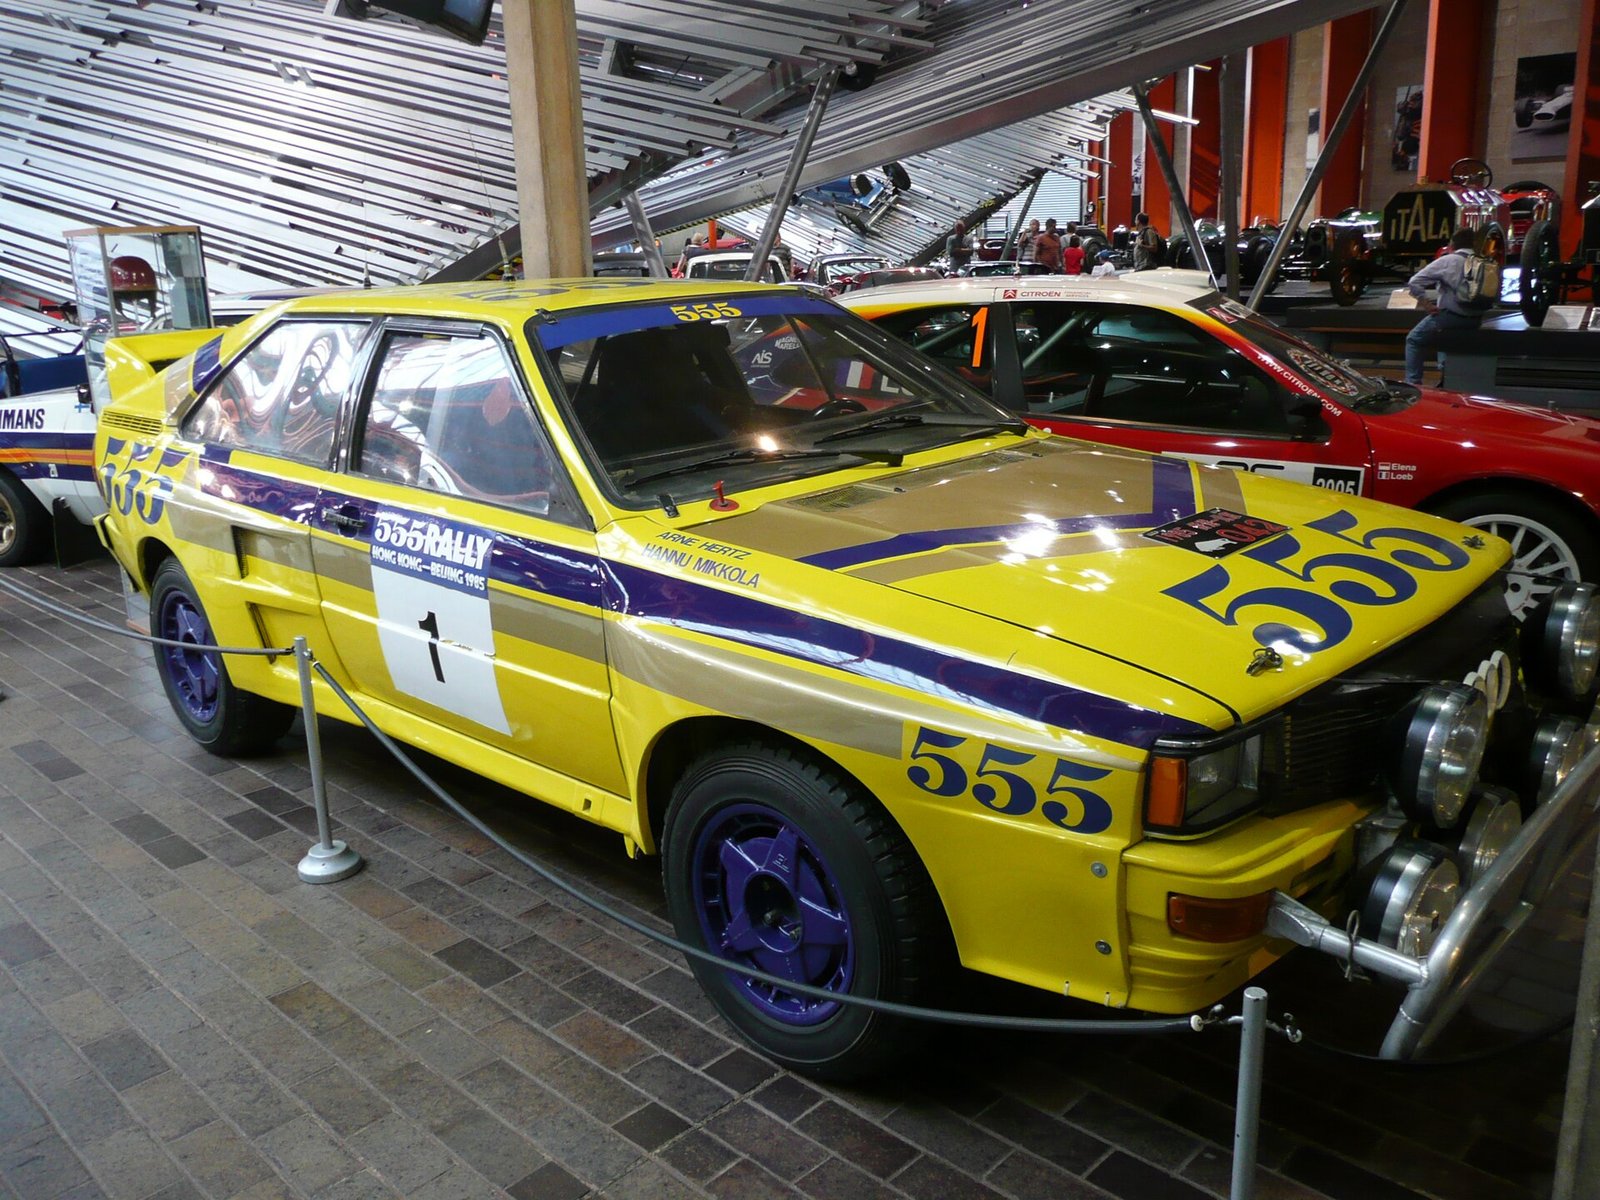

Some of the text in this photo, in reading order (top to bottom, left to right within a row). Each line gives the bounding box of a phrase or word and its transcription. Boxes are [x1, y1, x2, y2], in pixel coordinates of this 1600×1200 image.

[1390, 194, 1450, 242] ITALA
[670, 302, 742, 322] 555
[1020, 290, 1061, 298] CITROËN
[971, 307, 988, 367] 1
[0, 408, 45, 430] MANS
[100, 436, 192, 525] 555
[1391, 463, 1417, 471] Elena
[1391, 472, 1413, 480] Loeb
[656, 531, 752, 560] ARNE HERTZ
[1216, 518, 1287, 543] 042
[372, 545, 396, 564] HONG
[464, 572, 485, 591] 1985
[641, 543, 760, 588] HANNU MIKKOLA
[1159, 509, 1471, 653] 555
[418, 610, 446, 684] 1
[906, 726, 1113, 835] 555
